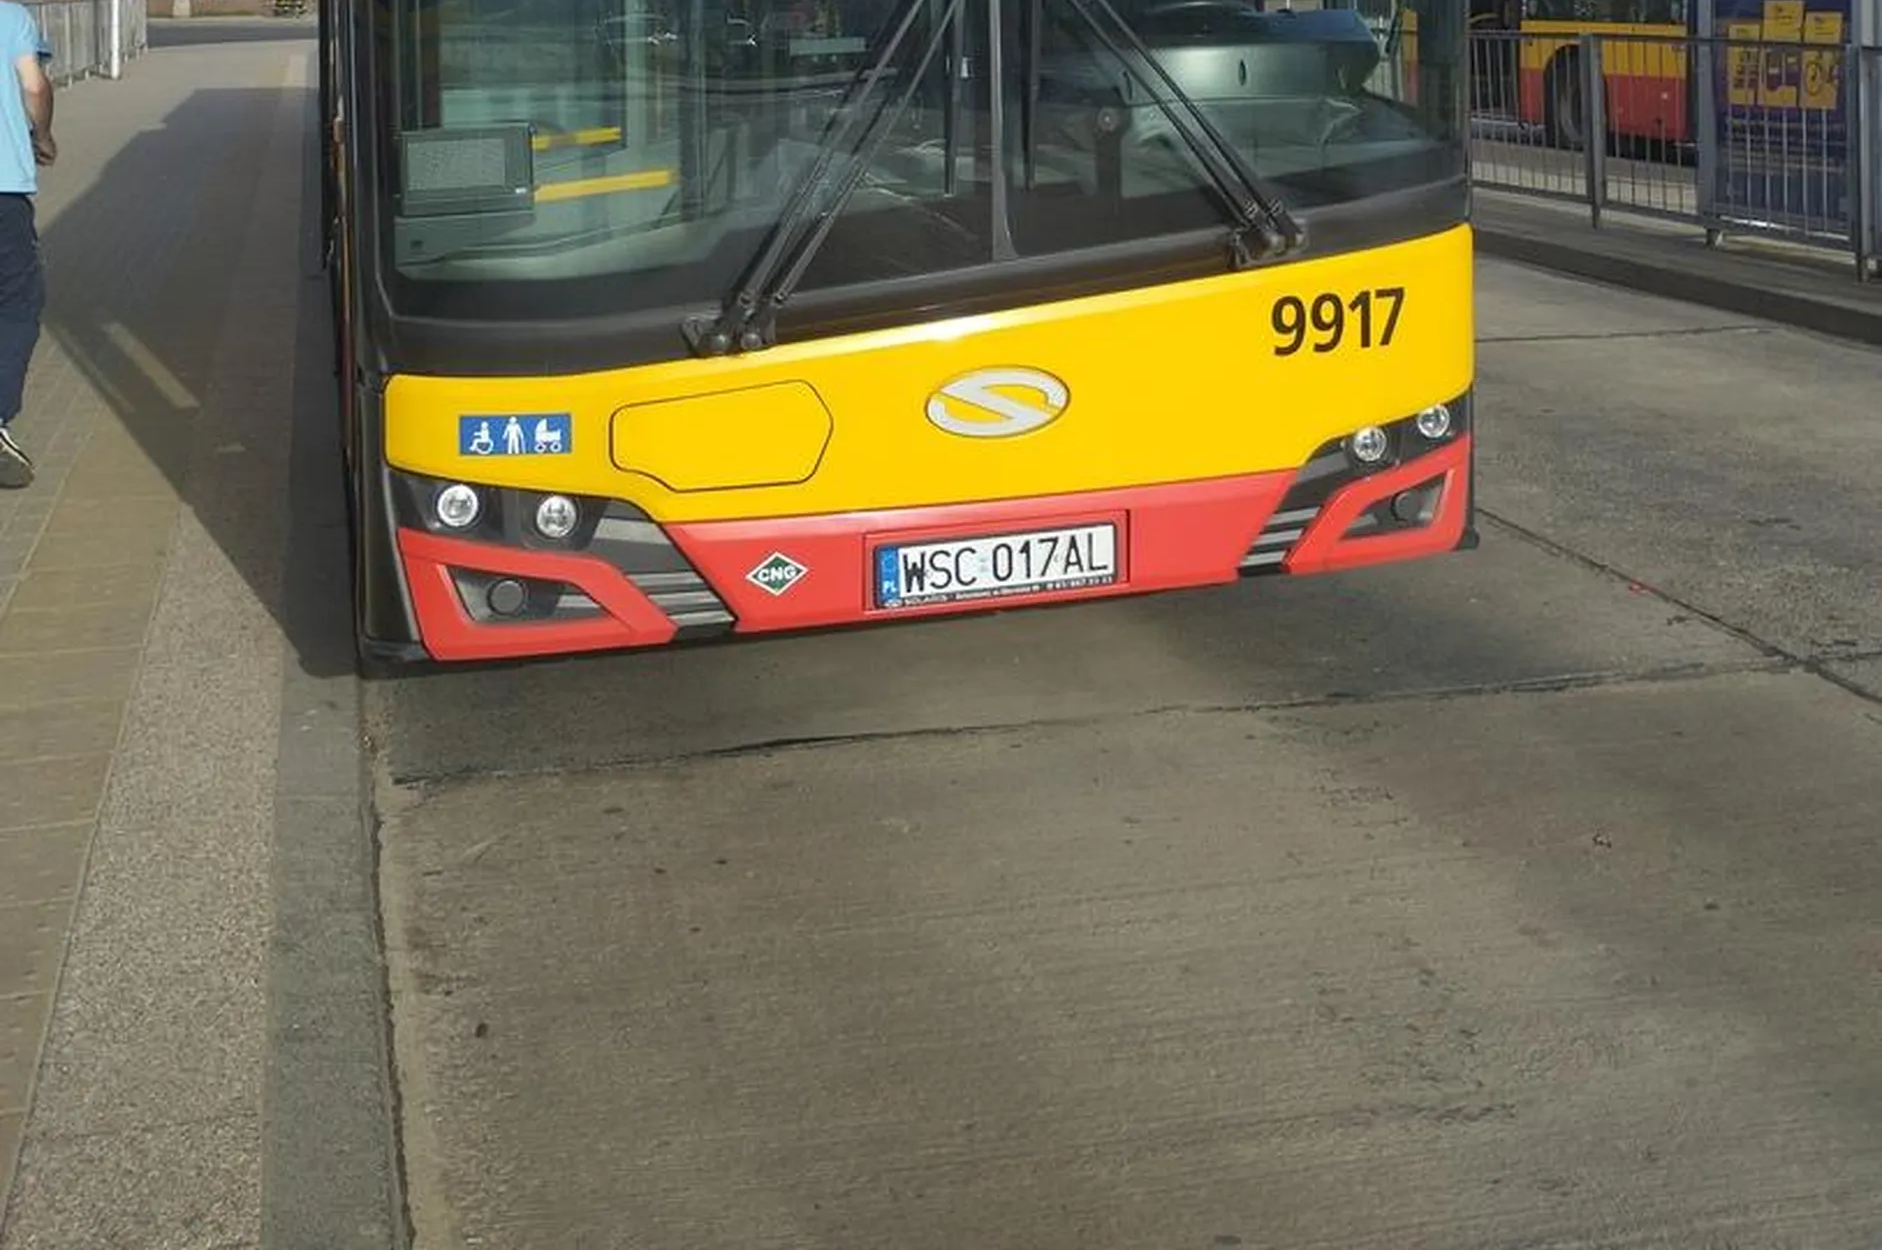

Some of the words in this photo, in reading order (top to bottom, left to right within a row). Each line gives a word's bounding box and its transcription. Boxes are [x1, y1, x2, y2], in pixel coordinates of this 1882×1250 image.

[1272, 287, 1404, 357] 9917
[757, 565, 797, 582] CNG
[903, 547, 977, 593] WSC
[992, 533, 1108, 582] 017AL
